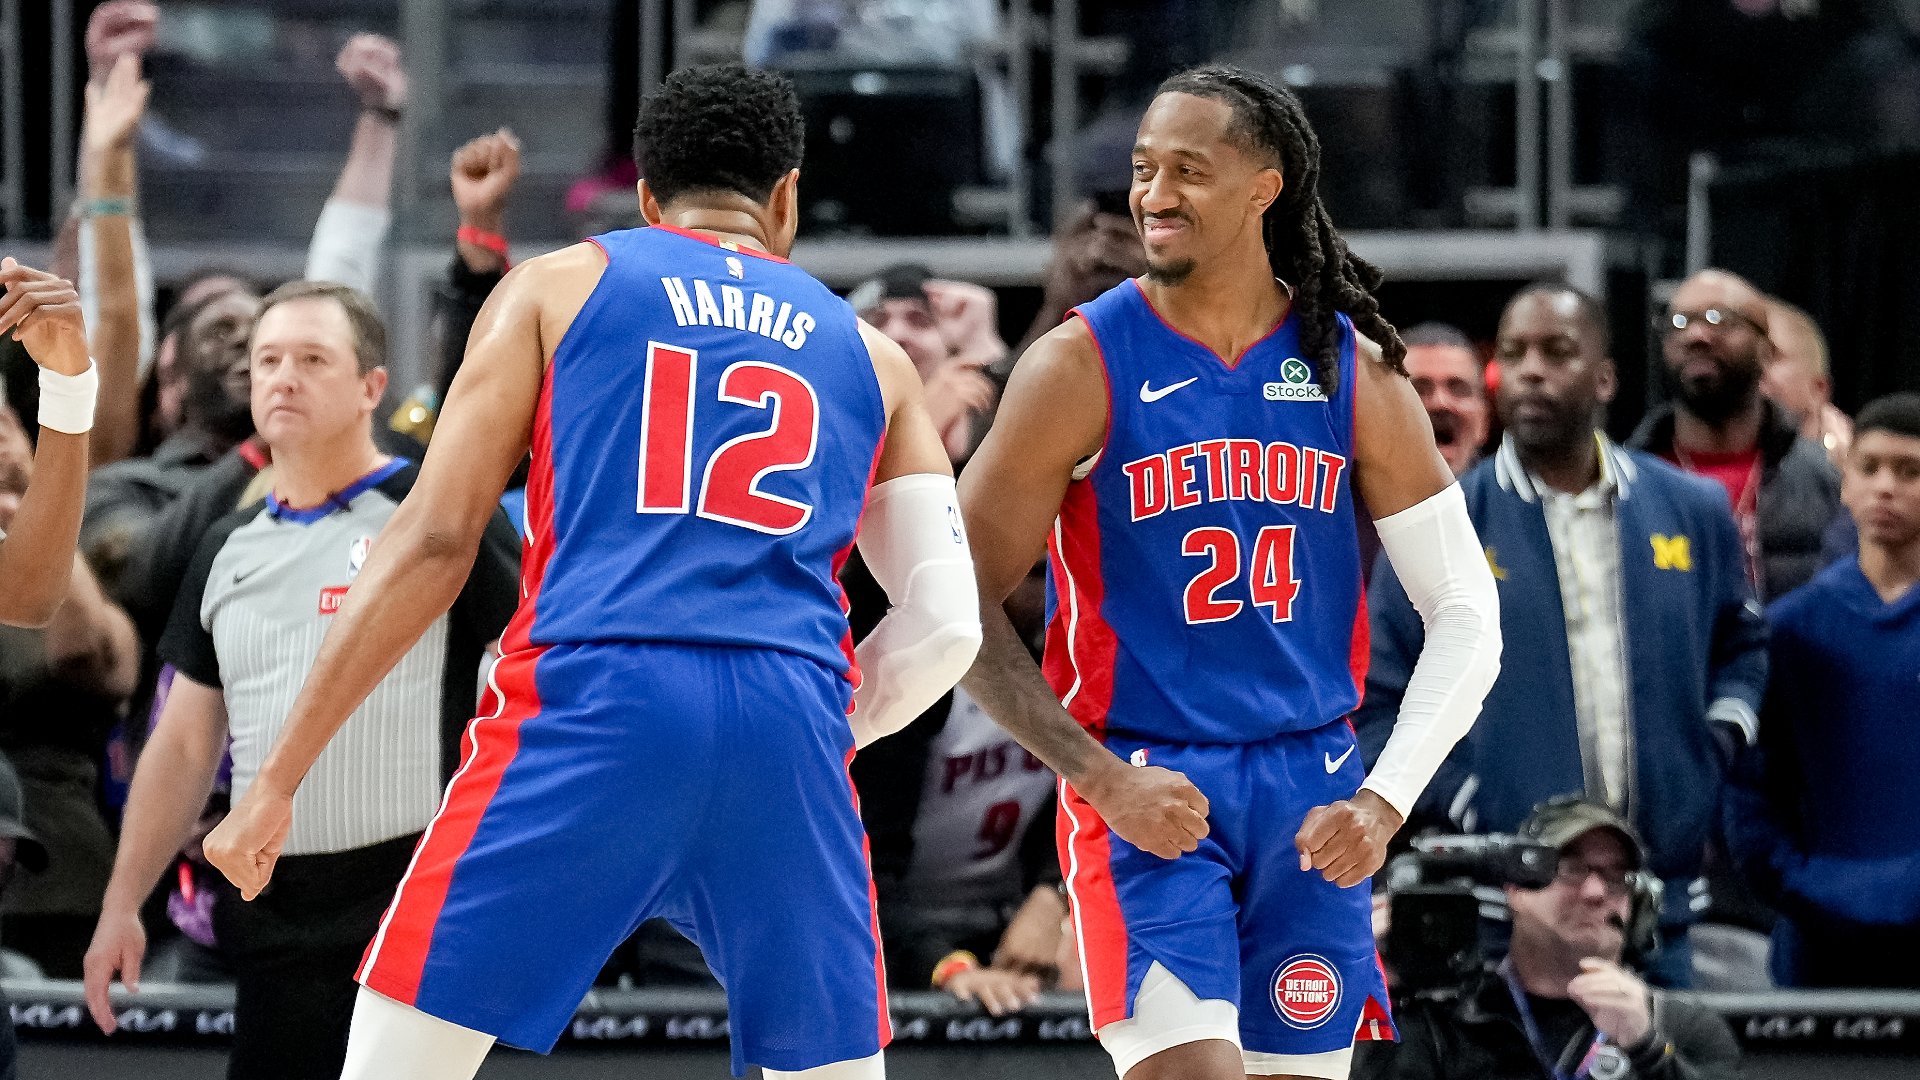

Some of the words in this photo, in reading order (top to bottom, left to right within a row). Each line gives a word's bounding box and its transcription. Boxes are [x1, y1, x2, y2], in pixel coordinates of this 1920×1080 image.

[660, 276, 817, 351] HARRIS
[636, 340, 820, 536] 12
[1122, 438, 1346, 523] DETROIT
[1181, 524, 1302, 625] 24
[1650, 533, 1691, 572] M
[970, 800, 1021, 862] 9
[1284, 979, 1329, 991] DETROIT
[1284, 990, 1329, 1003] PISTONS
